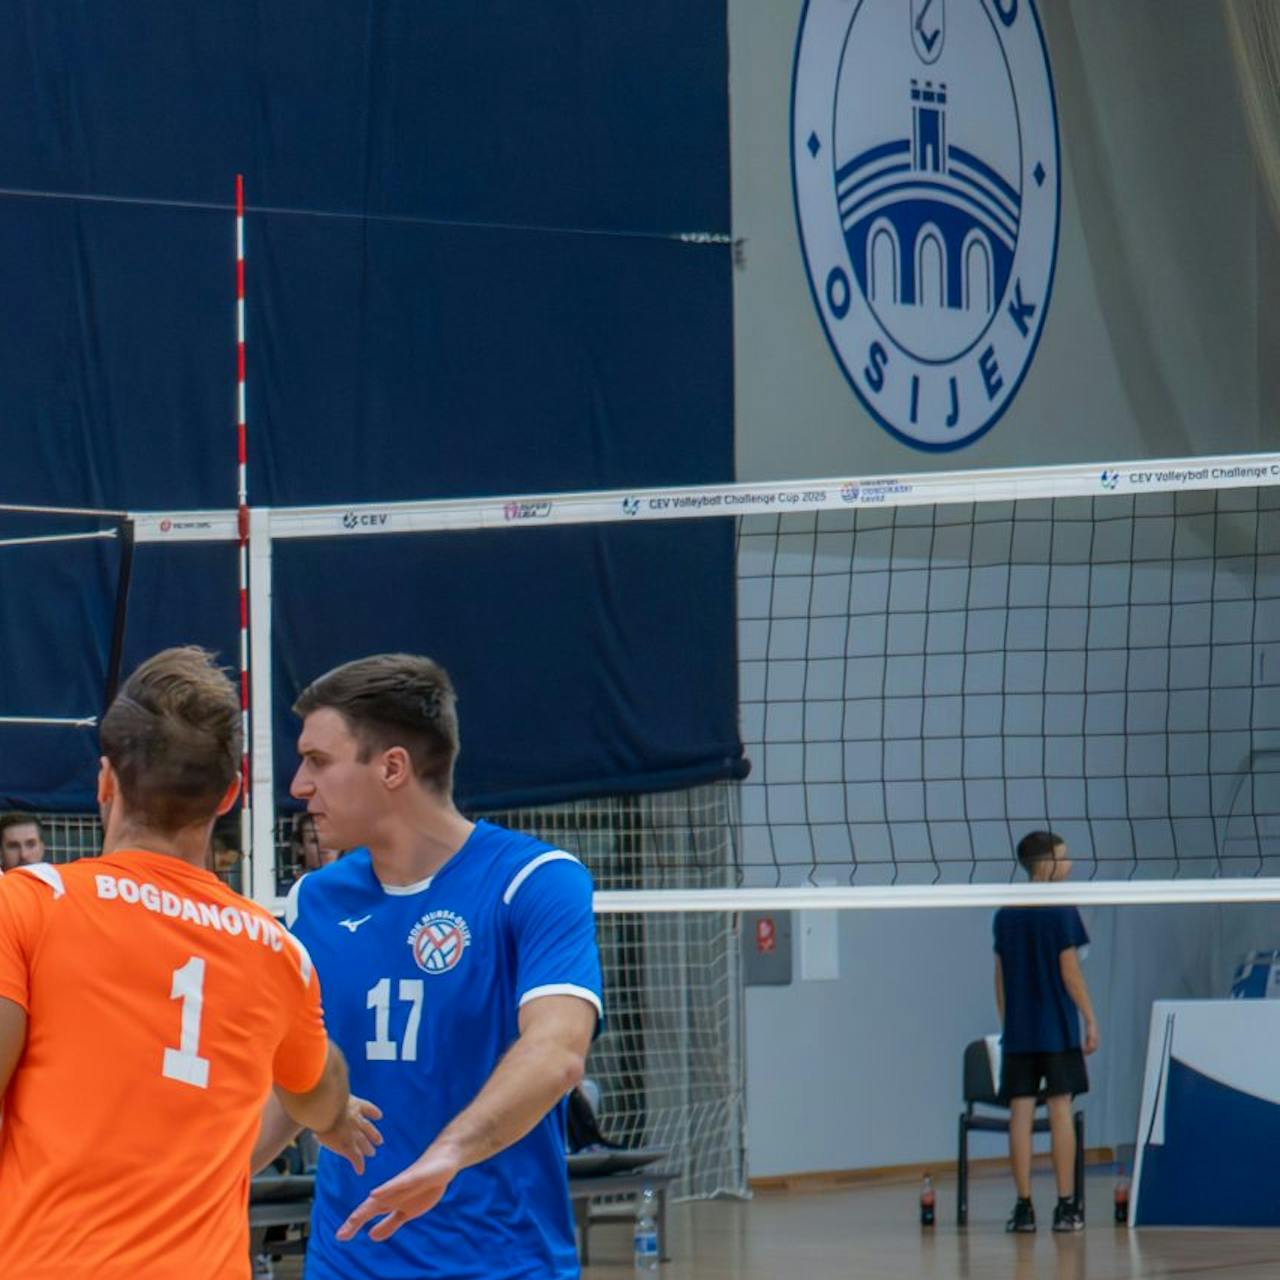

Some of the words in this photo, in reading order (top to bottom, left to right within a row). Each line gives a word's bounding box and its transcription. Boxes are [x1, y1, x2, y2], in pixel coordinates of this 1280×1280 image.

[826, 266, 1037, 428] OSIJEK
[1129, 472, 1154, 484] CEV
[1155, 468, 1210, 484] Volleyball
[1211, 465, 1268, 479] Challenge
[361, 513, 388, 527] CEV
[649, 497, 672, 510] CEV
[672, 494, 723, 509] Volleyball
[724, 493, 776, 505] Challenge
[778, 492, 801, 504] Cup
[161, 955, 211, 1090] 1
[365, 977, 425, 1062] 17
